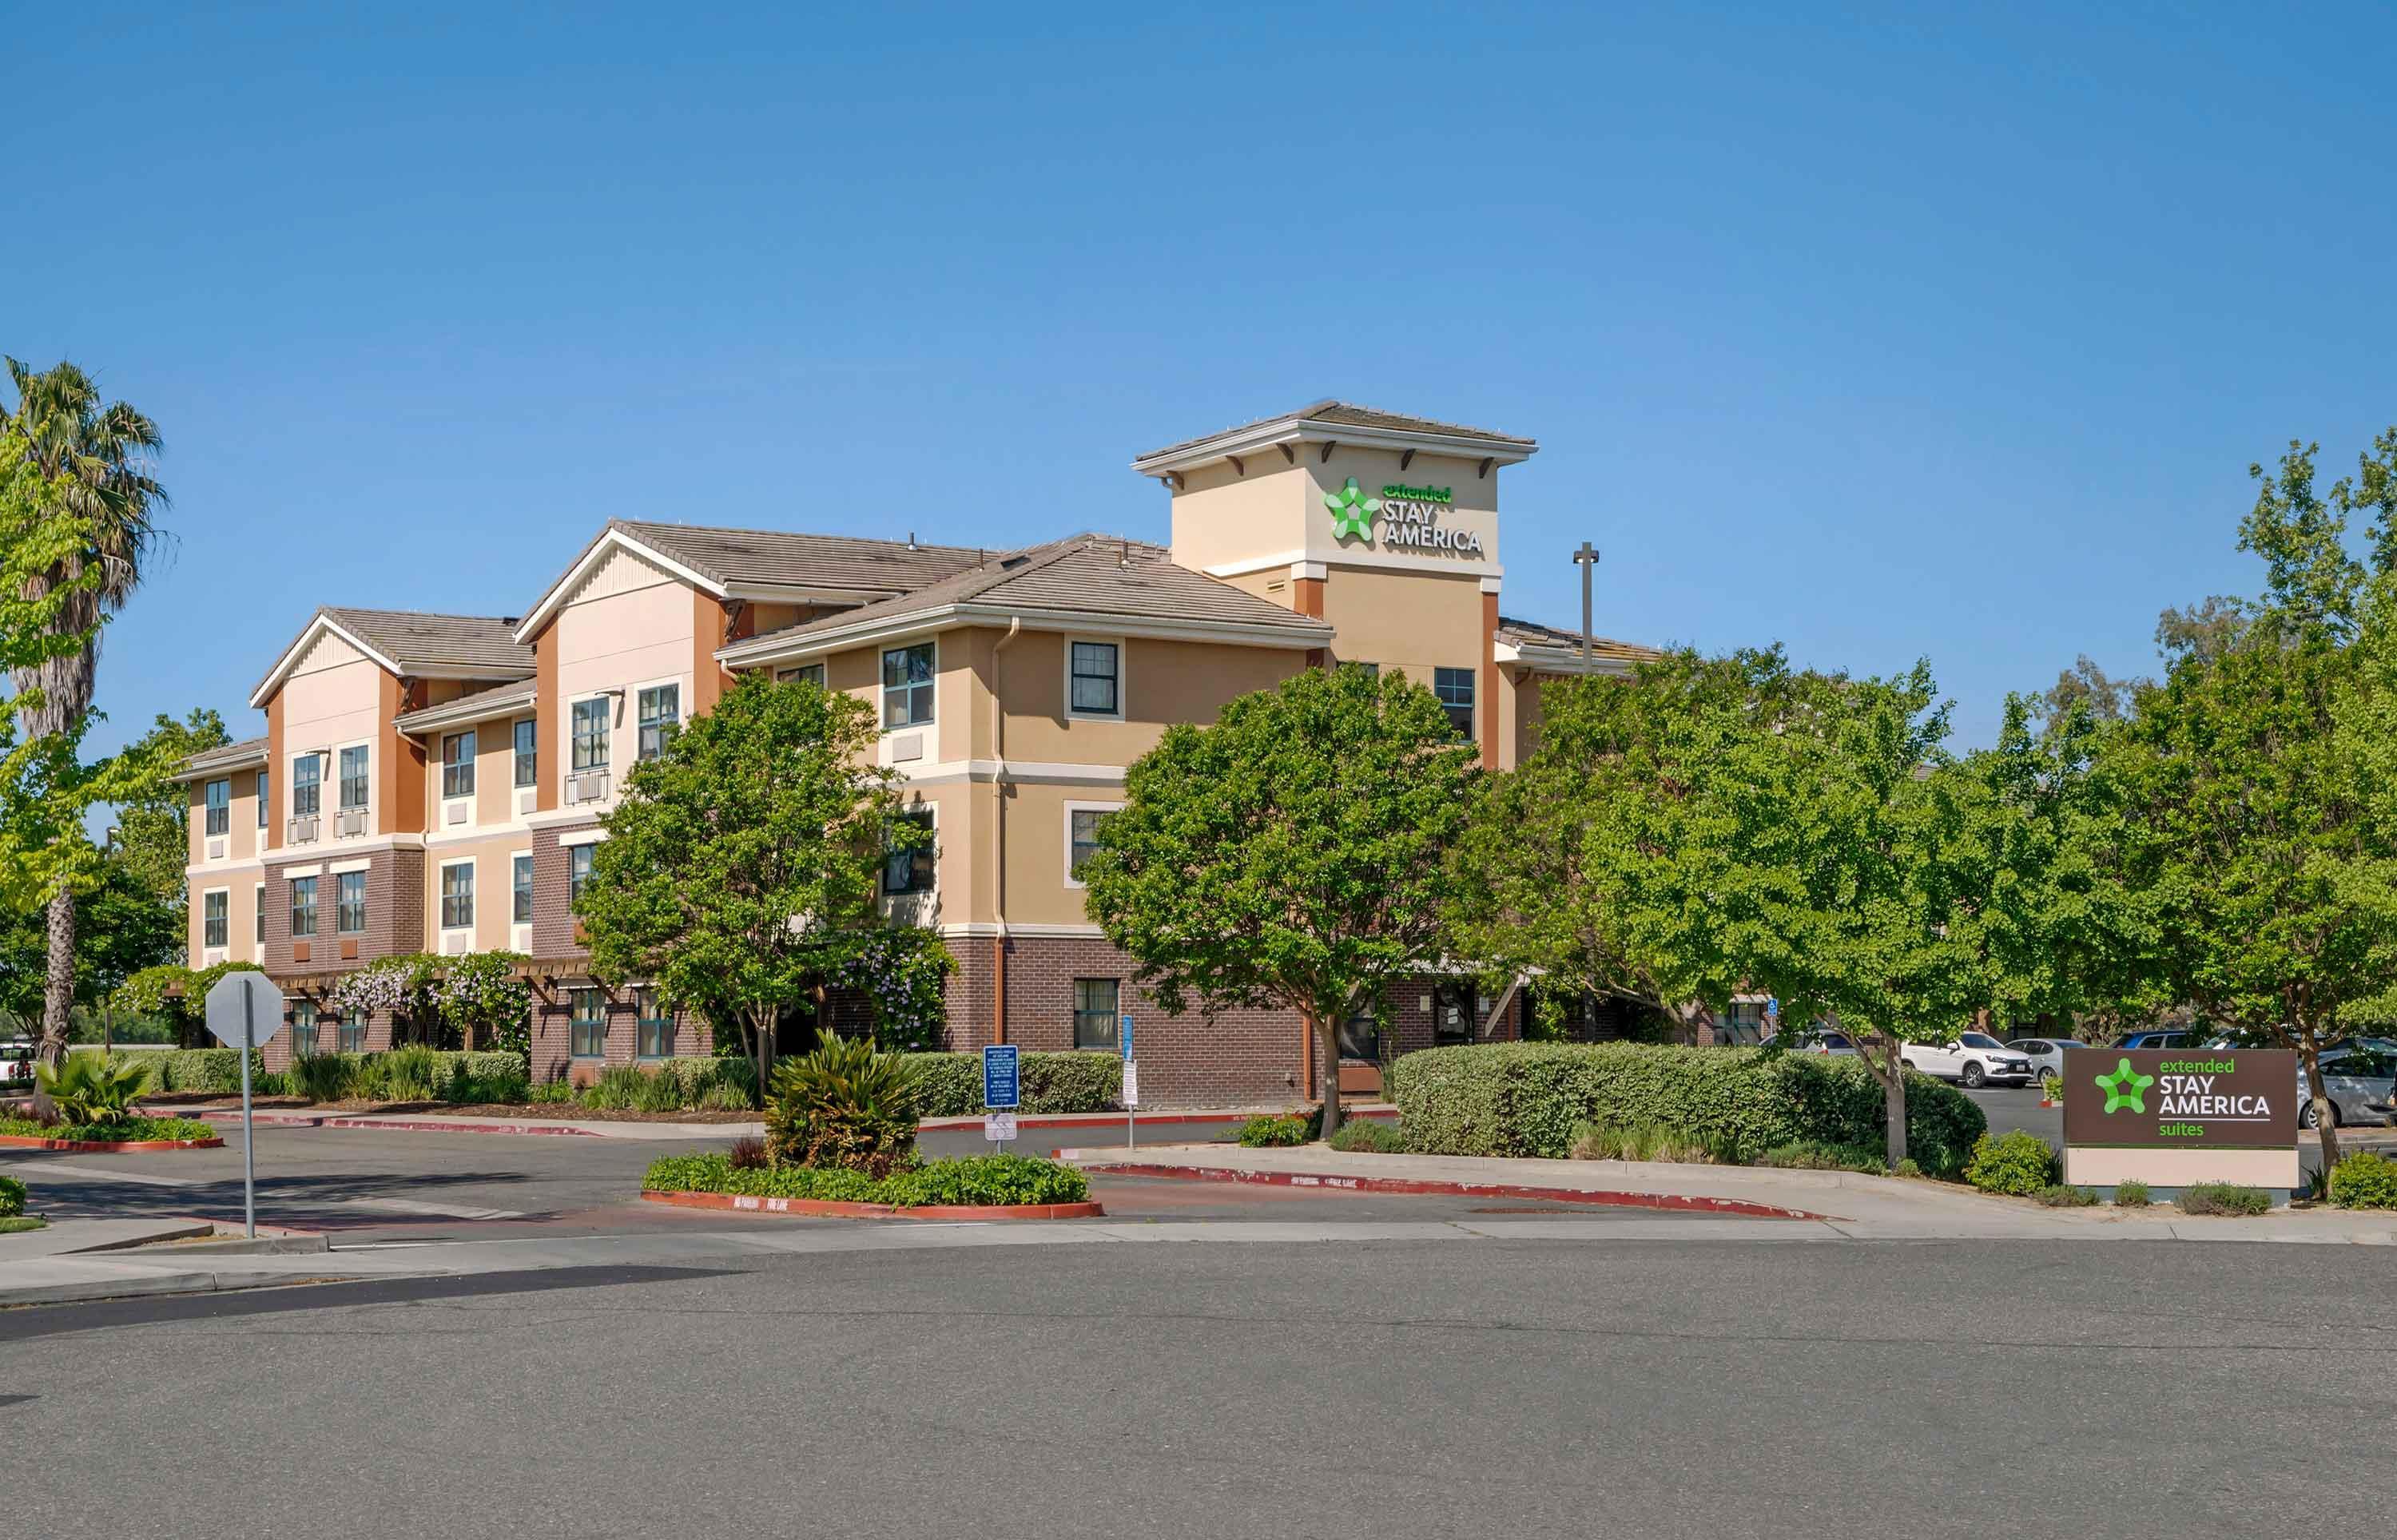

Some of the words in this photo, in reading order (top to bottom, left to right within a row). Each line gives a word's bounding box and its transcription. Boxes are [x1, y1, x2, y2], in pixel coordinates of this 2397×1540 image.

[1383, 484, 1452, 503] extended
[1383, 499, 1433, 525] STAY
[1384, 523, 1482, 552] AMERICA
[2160, 1058, 2235, 1074] extended
[2160, 1075, 2216, 1094] STAY
[2158, 1095, 2271, 1115] AMERICA
[2160, 1121, 2204, 1137] suites
